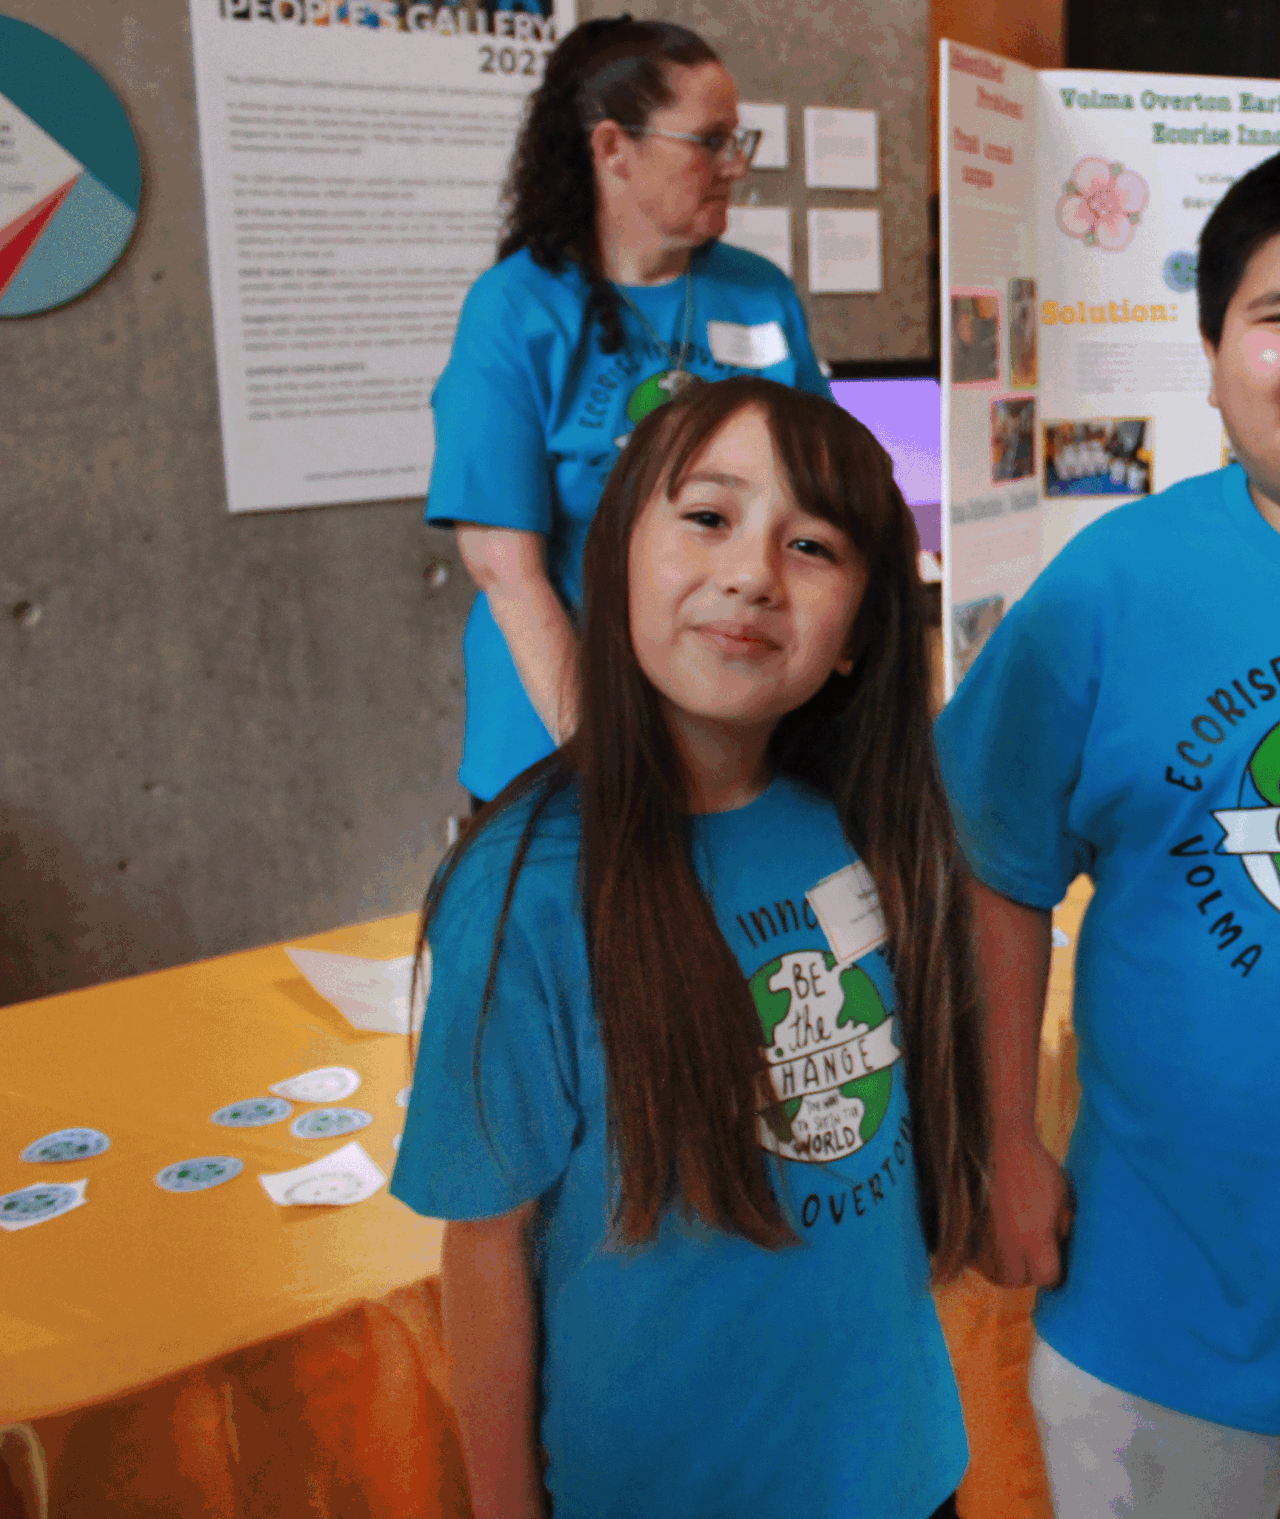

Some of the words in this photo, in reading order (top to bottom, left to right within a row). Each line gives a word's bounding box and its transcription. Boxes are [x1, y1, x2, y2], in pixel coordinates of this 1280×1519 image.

[406, 4, 556, 43] GALLERY
[477, 45, 551, 76] 202
[1060, 88, 1134, 110] Volma
[1140, 90, 1232, 113] Overton
[1152, 122, 1231, 145] Ecorise
[1042, 299, 1178, 325] Solution:
[1168, 834, 1263, 979] VOLMA
[791, 961, 827, 1001] BE
[789, 1004, 832, 1052] the
[780, 1037, 875, 1098] HANGE
[793, 1126, 856, 1155] WORLD
